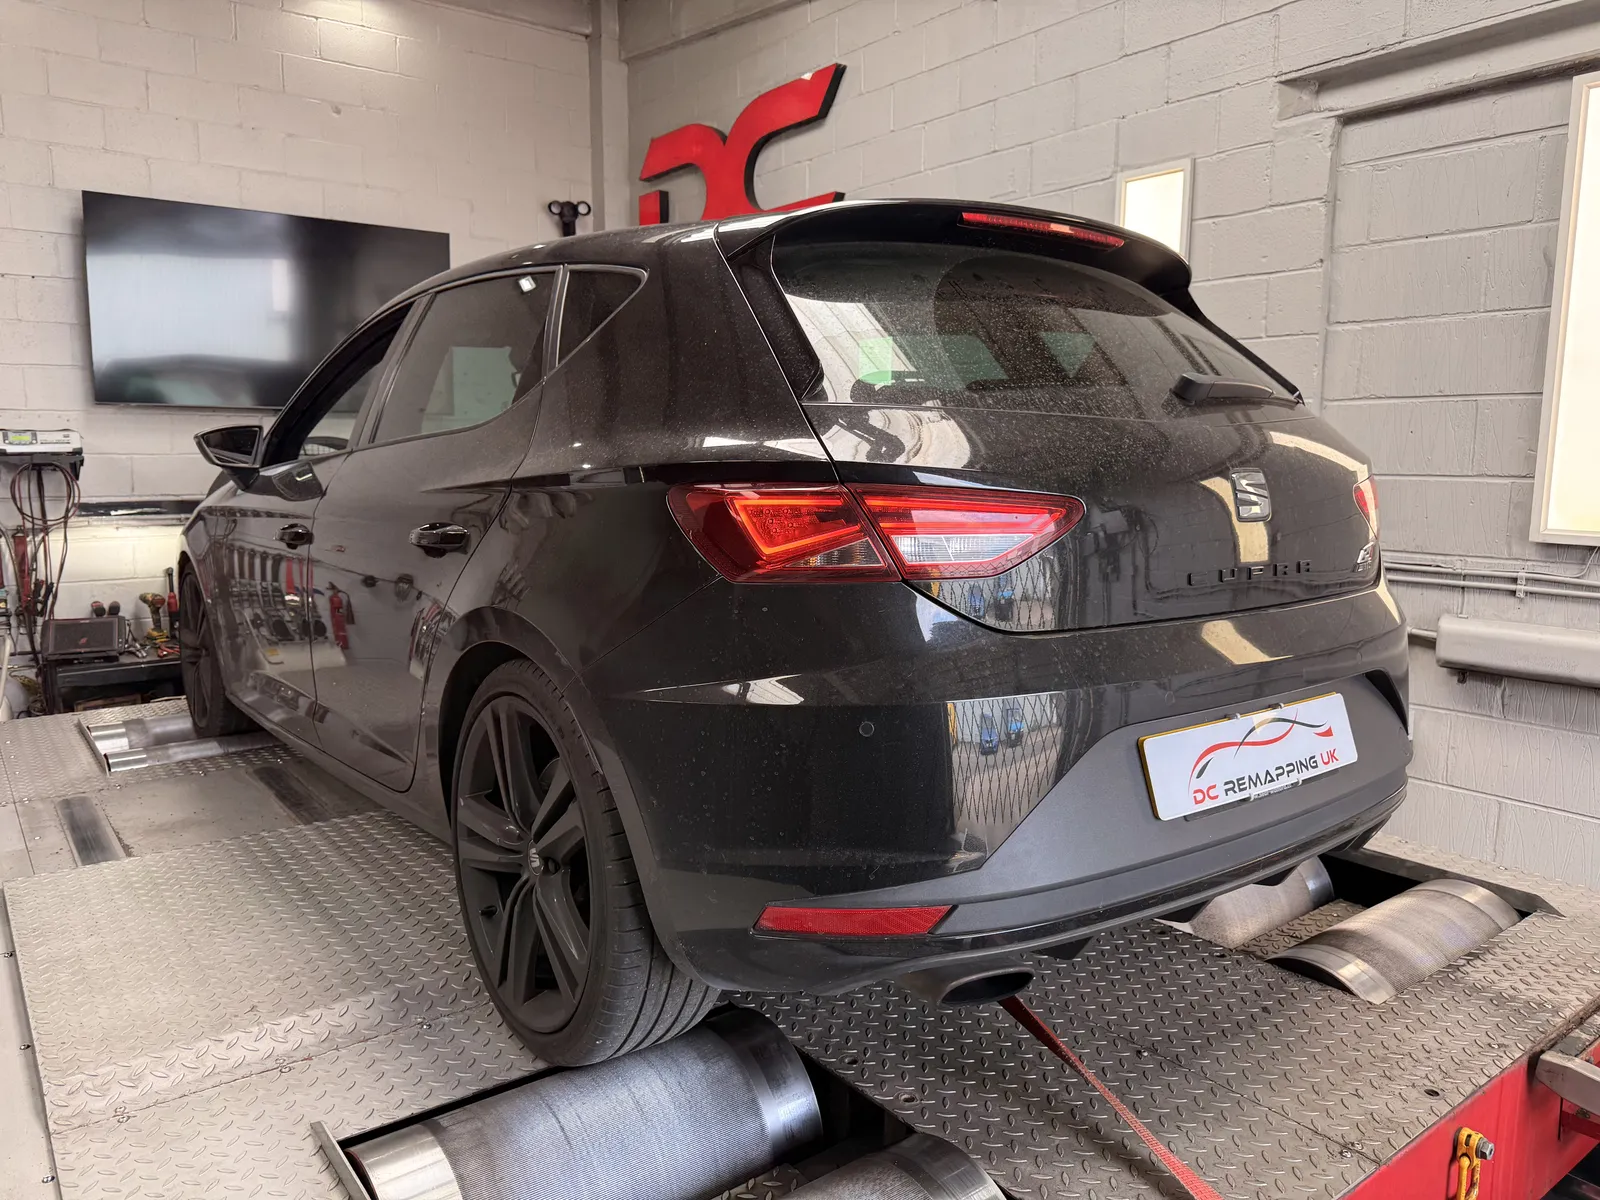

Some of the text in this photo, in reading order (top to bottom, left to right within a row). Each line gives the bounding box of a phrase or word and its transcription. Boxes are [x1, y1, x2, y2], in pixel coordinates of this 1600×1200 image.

[1192, 784, 1219, 804] DC
[1224, 755, 1318, 796] REMAPPING
[1320, 748, 1339, 765] UK
